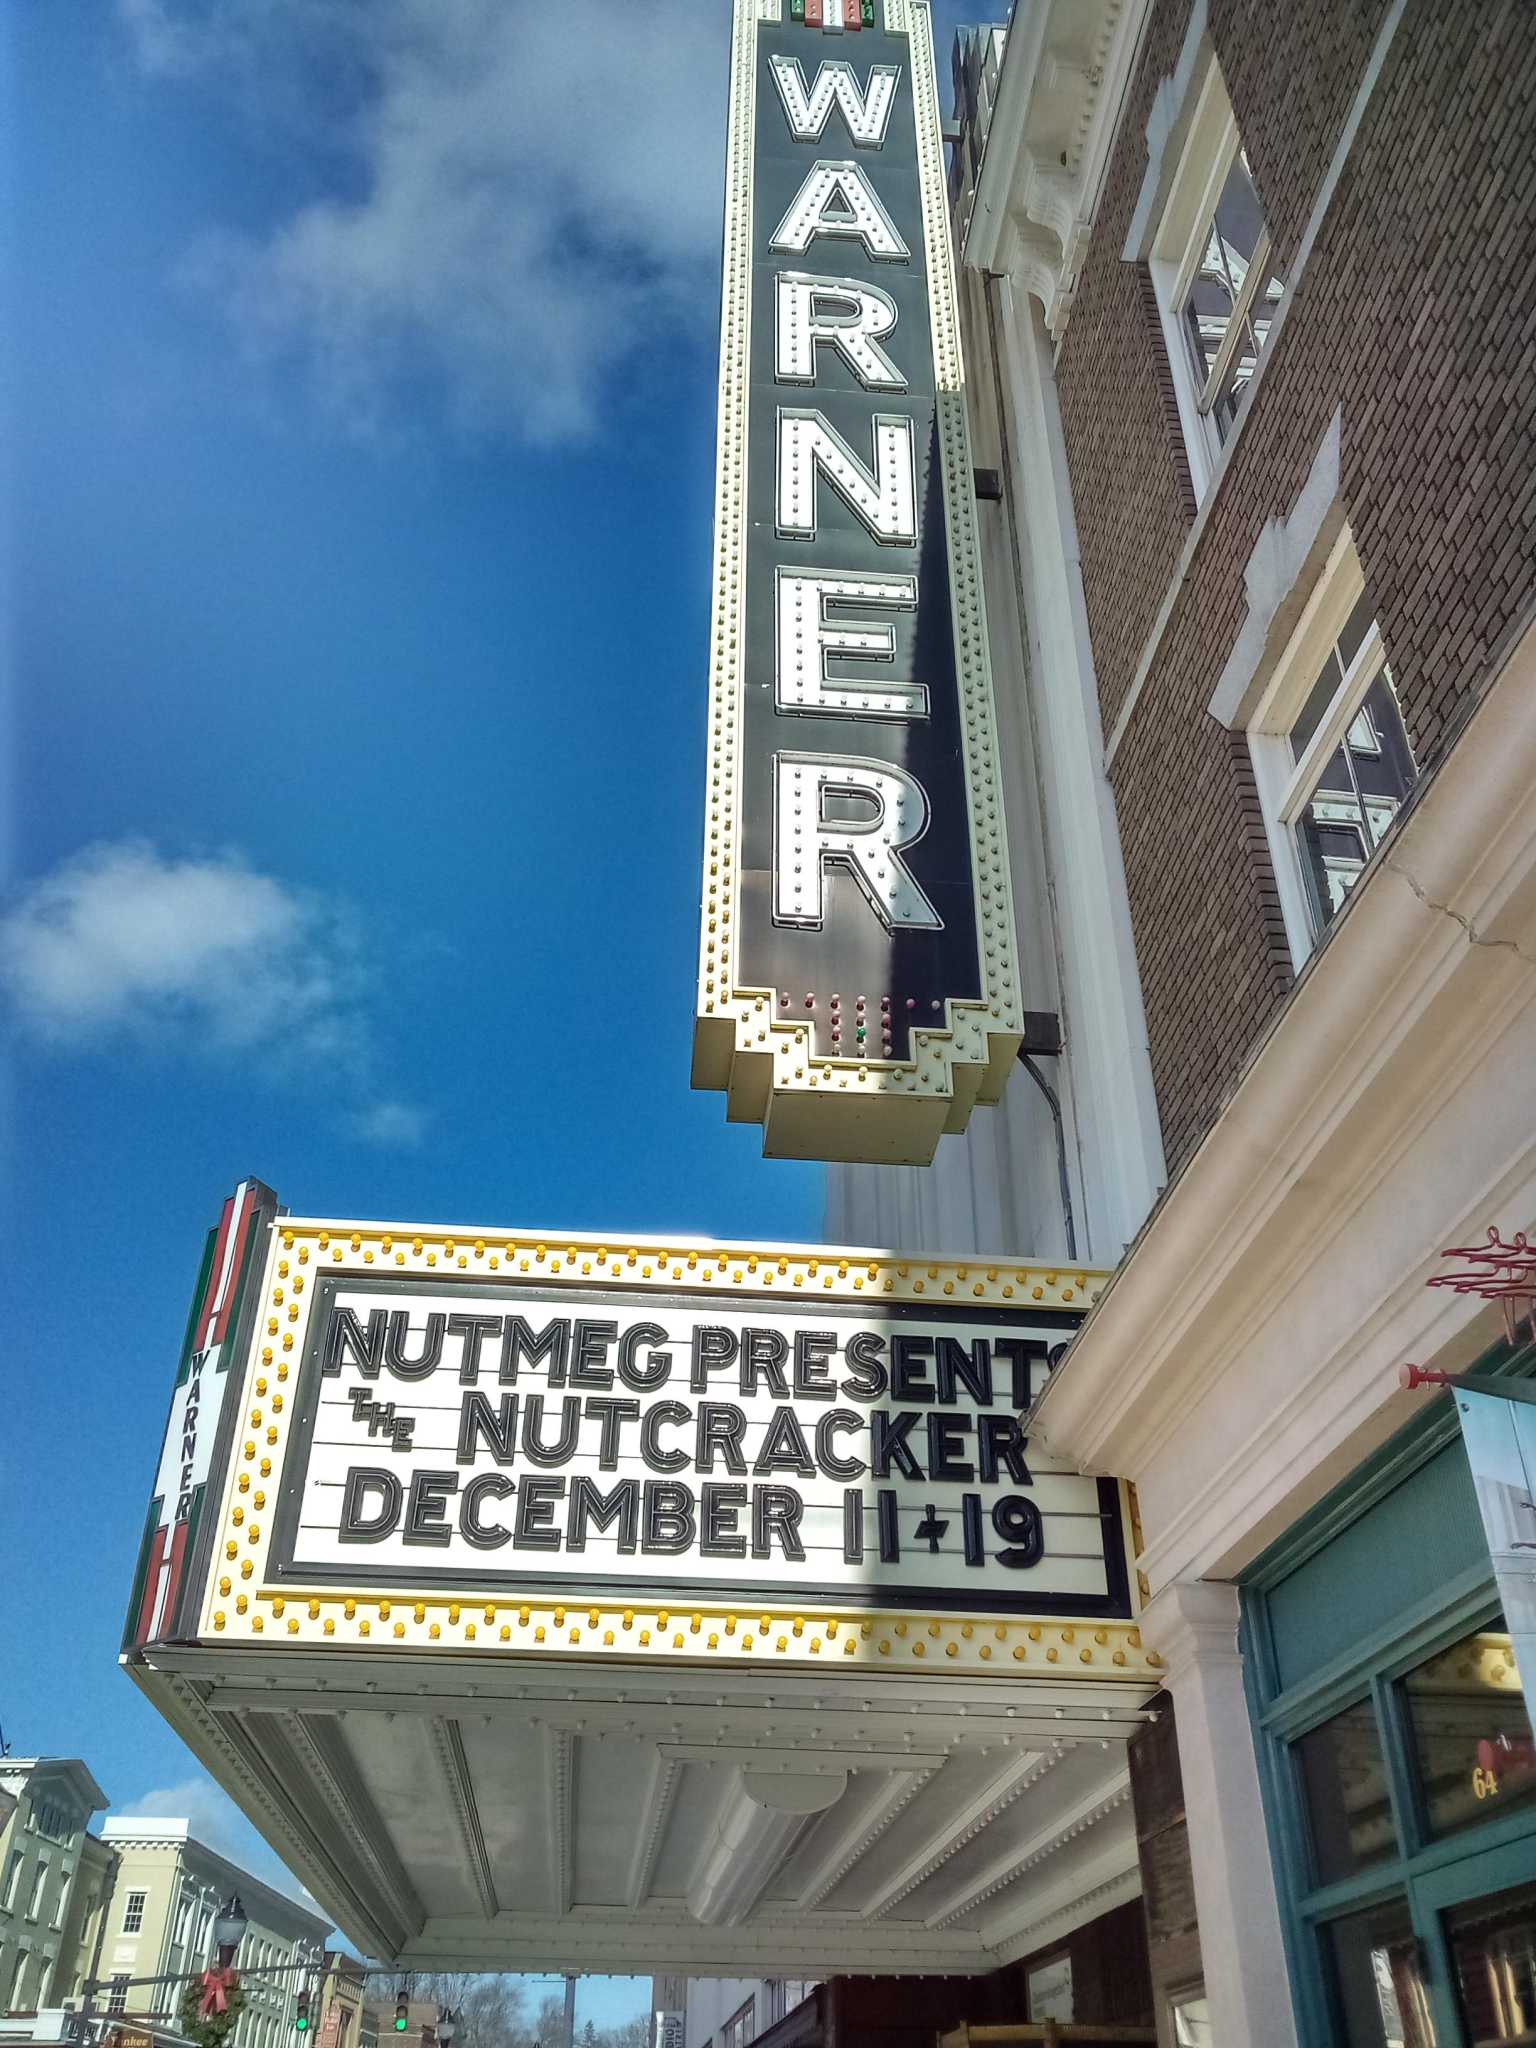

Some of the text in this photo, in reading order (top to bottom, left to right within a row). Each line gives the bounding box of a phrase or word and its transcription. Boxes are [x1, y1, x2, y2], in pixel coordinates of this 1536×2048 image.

[767, 55, 946, 936] WARNER
[321, 1307, 673, 1393] NUTMEG
[175, 1350, 210, 1521] WARNER
[348, 1387, 1033, 1486] THE NUTCRACKER
[338, 1466, 806, 1562] DECEMBER
[1472, 1767, 1498, 1799] 64
